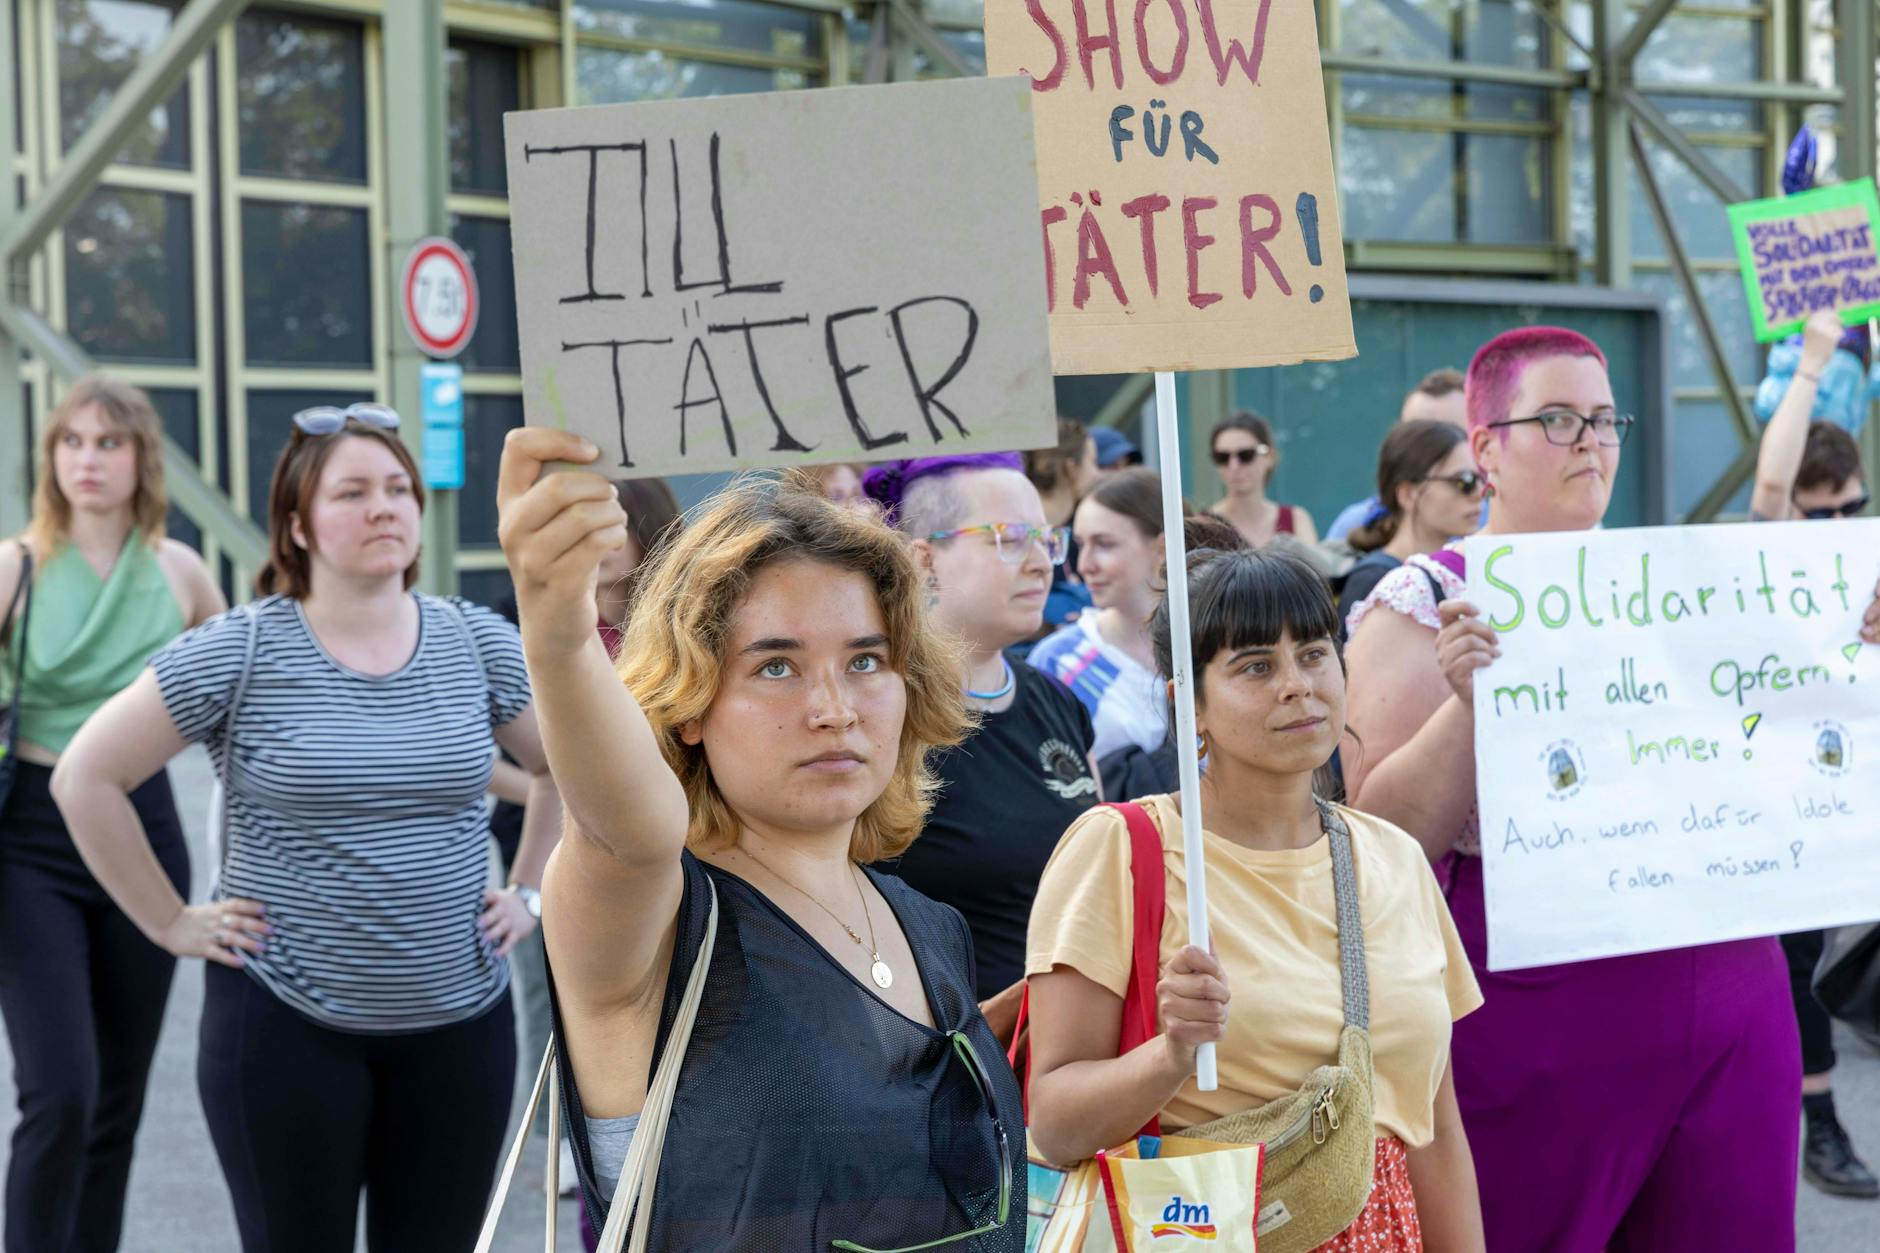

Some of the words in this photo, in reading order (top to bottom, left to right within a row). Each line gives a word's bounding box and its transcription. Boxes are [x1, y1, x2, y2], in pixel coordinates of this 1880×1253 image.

[1019, 0, 1271, 92] SHOW
[1109, 98, 1219, 164] FÜR
[524, 131, 785, 304] TILL
[1041, 189, 1324, 313] TÄTER!
[562, 296, 979, 468] TÄTER
[1485, 545, 1849, 632] Solidarität
[1494, 667, 1568, 717] mit
[1605, 658, 1668, 705] allen
[1600, 821, 1658, 840] wenn
[1681, 803, 1762, 832] dafür
[1793, 794, 1854, 820] Idole
[1609, 866, 1674, 893] fallen
[1163, 1196, 1210, 1223] dm
